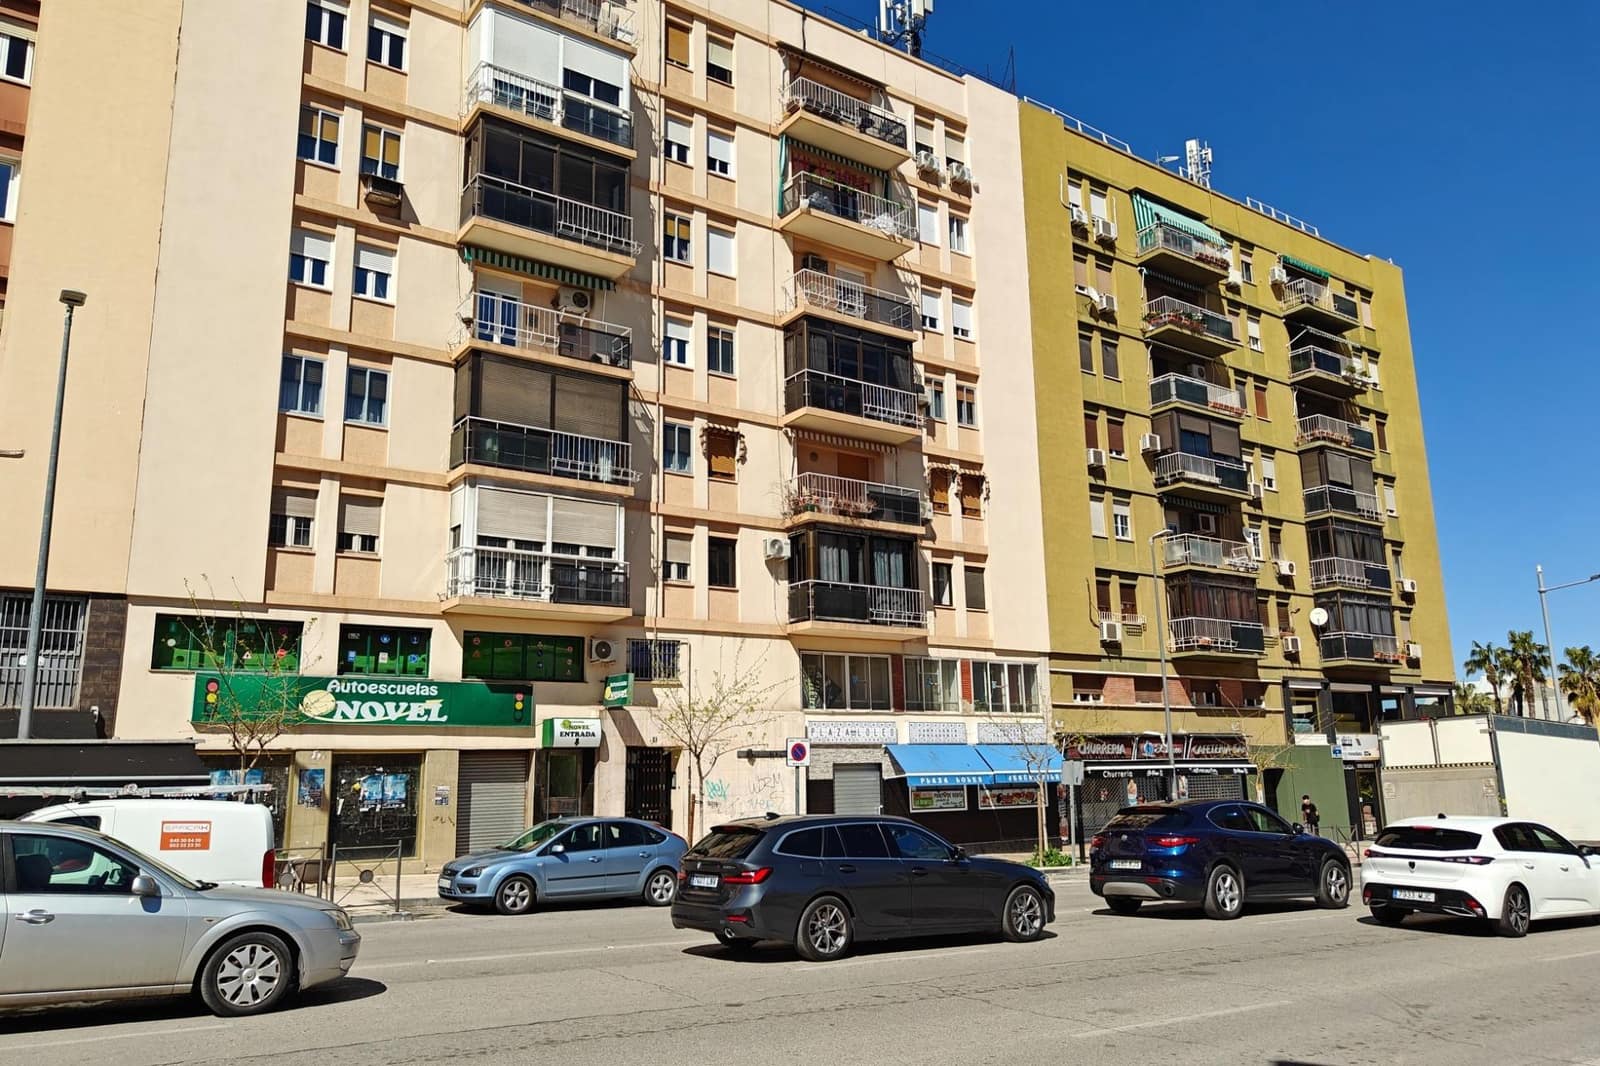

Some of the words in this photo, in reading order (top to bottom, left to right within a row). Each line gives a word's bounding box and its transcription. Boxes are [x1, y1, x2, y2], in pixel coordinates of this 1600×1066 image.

[326, 679, 438, 696] Autoescuelas
[333, 700, 448, 722] NOVEL
[810, 727, 850, 737] PLAZA
